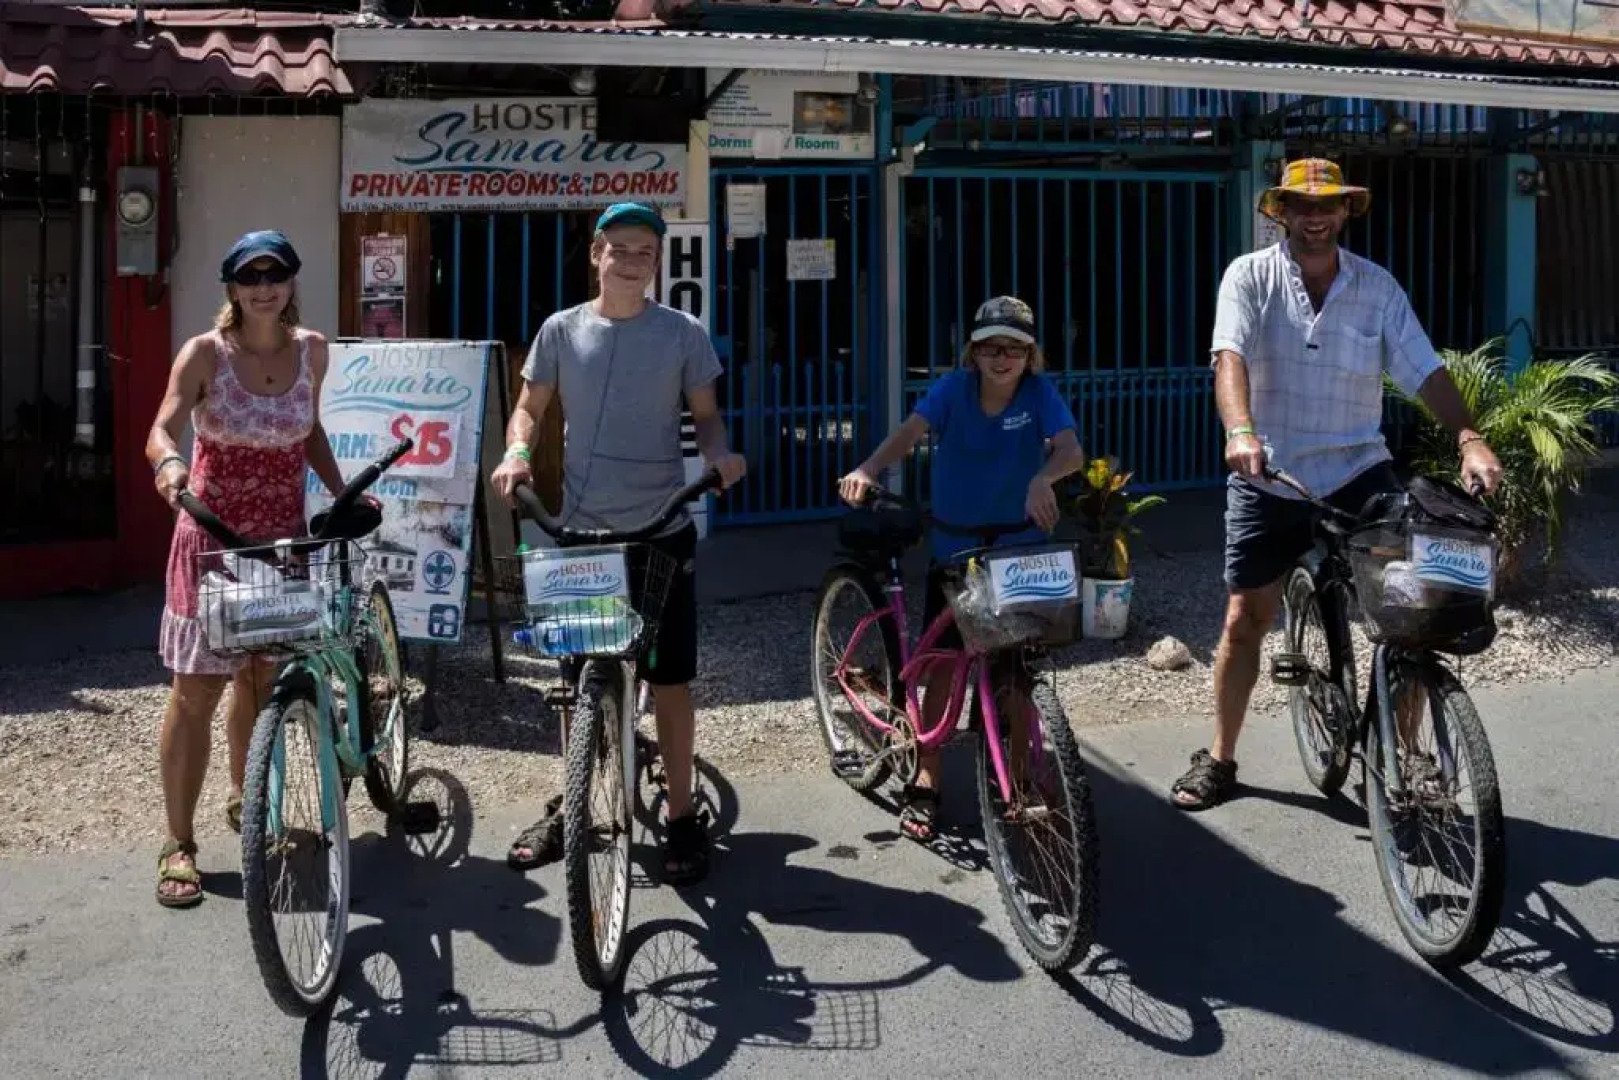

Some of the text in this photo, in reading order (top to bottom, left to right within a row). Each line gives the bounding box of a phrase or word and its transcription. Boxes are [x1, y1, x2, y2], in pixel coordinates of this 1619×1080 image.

[473, 103, 597, 131] HOSTE
[393, 111, 665, 168] Samara
[350, 171, 679, 197] PRIVATE ROOMS & DORMS
[332, 356, 472, 396] Samara
[560, 562, 605, 576] HOSTEL
[1019, 556, 1062, 570] HOSTEL
[1423, 542, 1486, 571] Samara
[542, 568, 620, 590] Samara
[1002, 562, 1072, 588] Samara
